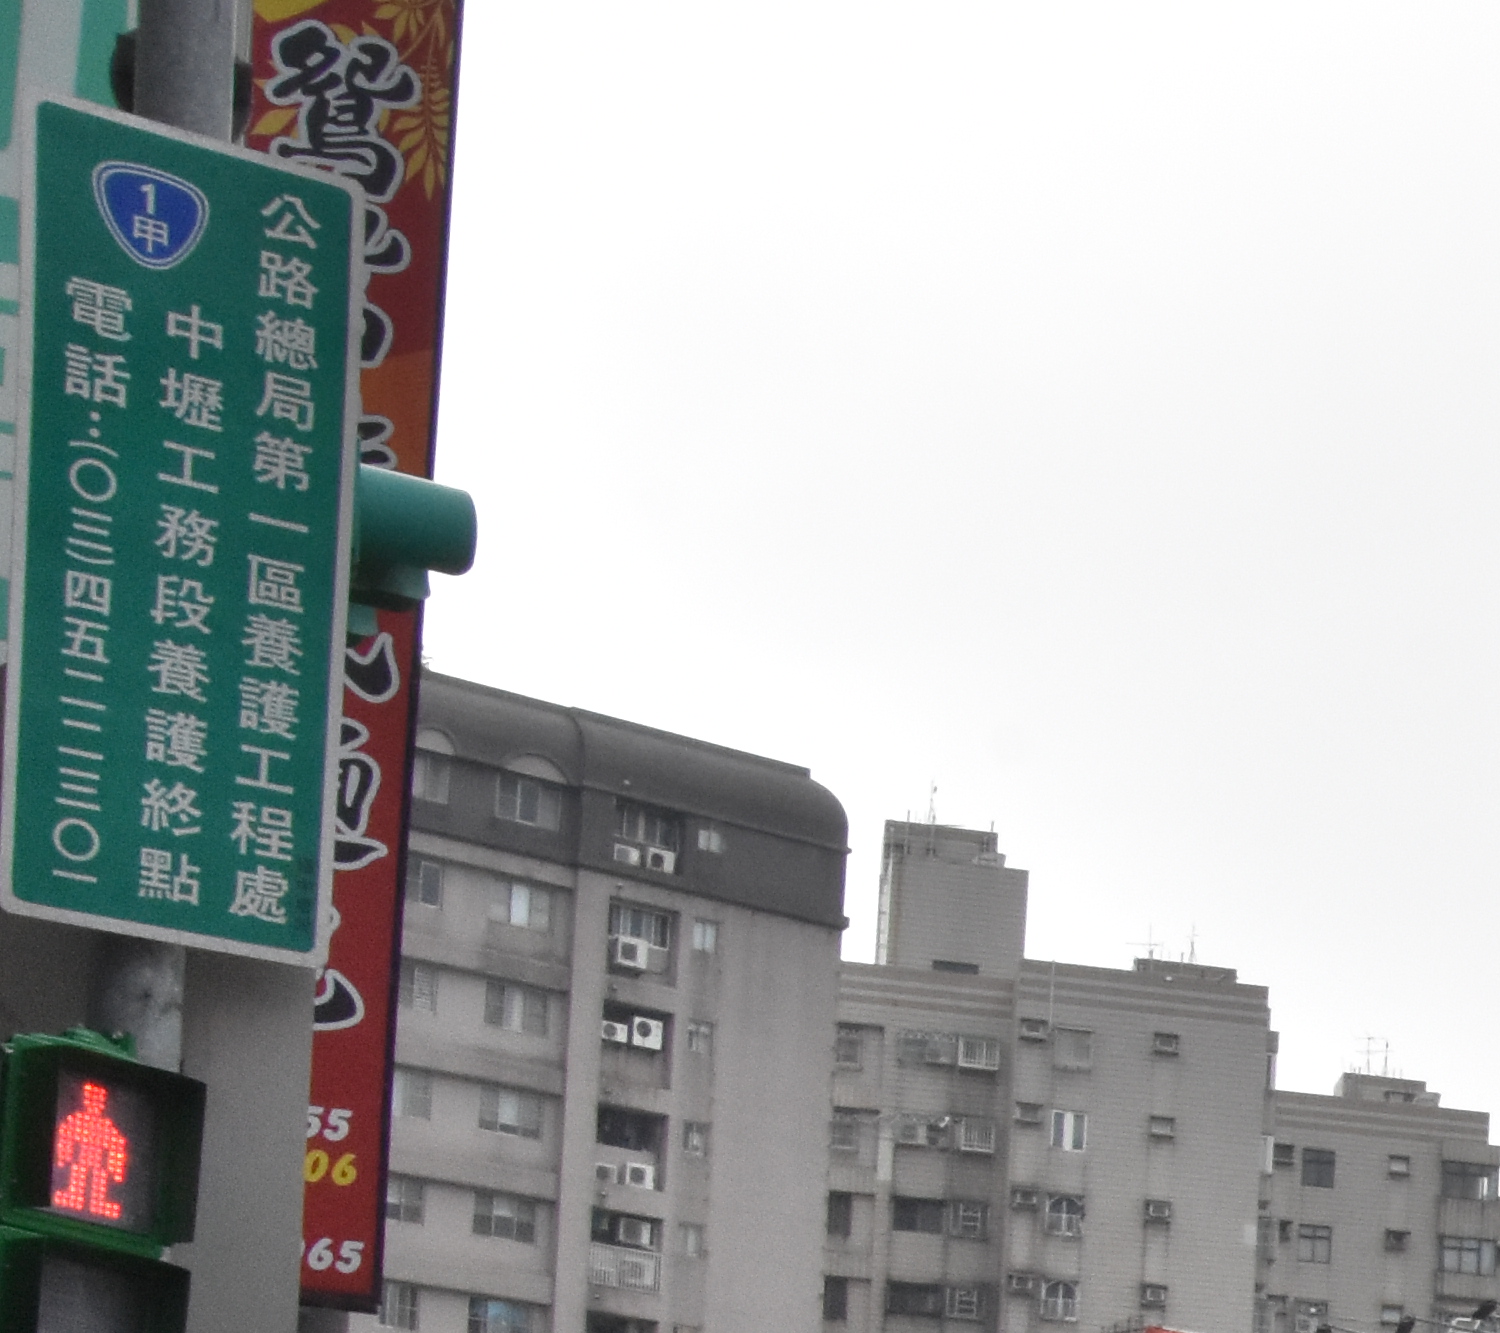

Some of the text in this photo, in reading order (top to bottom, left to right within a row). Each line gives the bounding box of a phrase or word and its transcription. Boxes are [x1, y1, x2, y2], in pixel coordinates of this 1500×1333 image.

[139, 180, 160, 214] 1
[130, 216, 171, 257] 甲
[229, 193, 320, 924] 公路總局第一區養護工程處
[137, 303, 225, 906] 中壢工務段養護終點
[301, 1236, 366, 1274] 65
